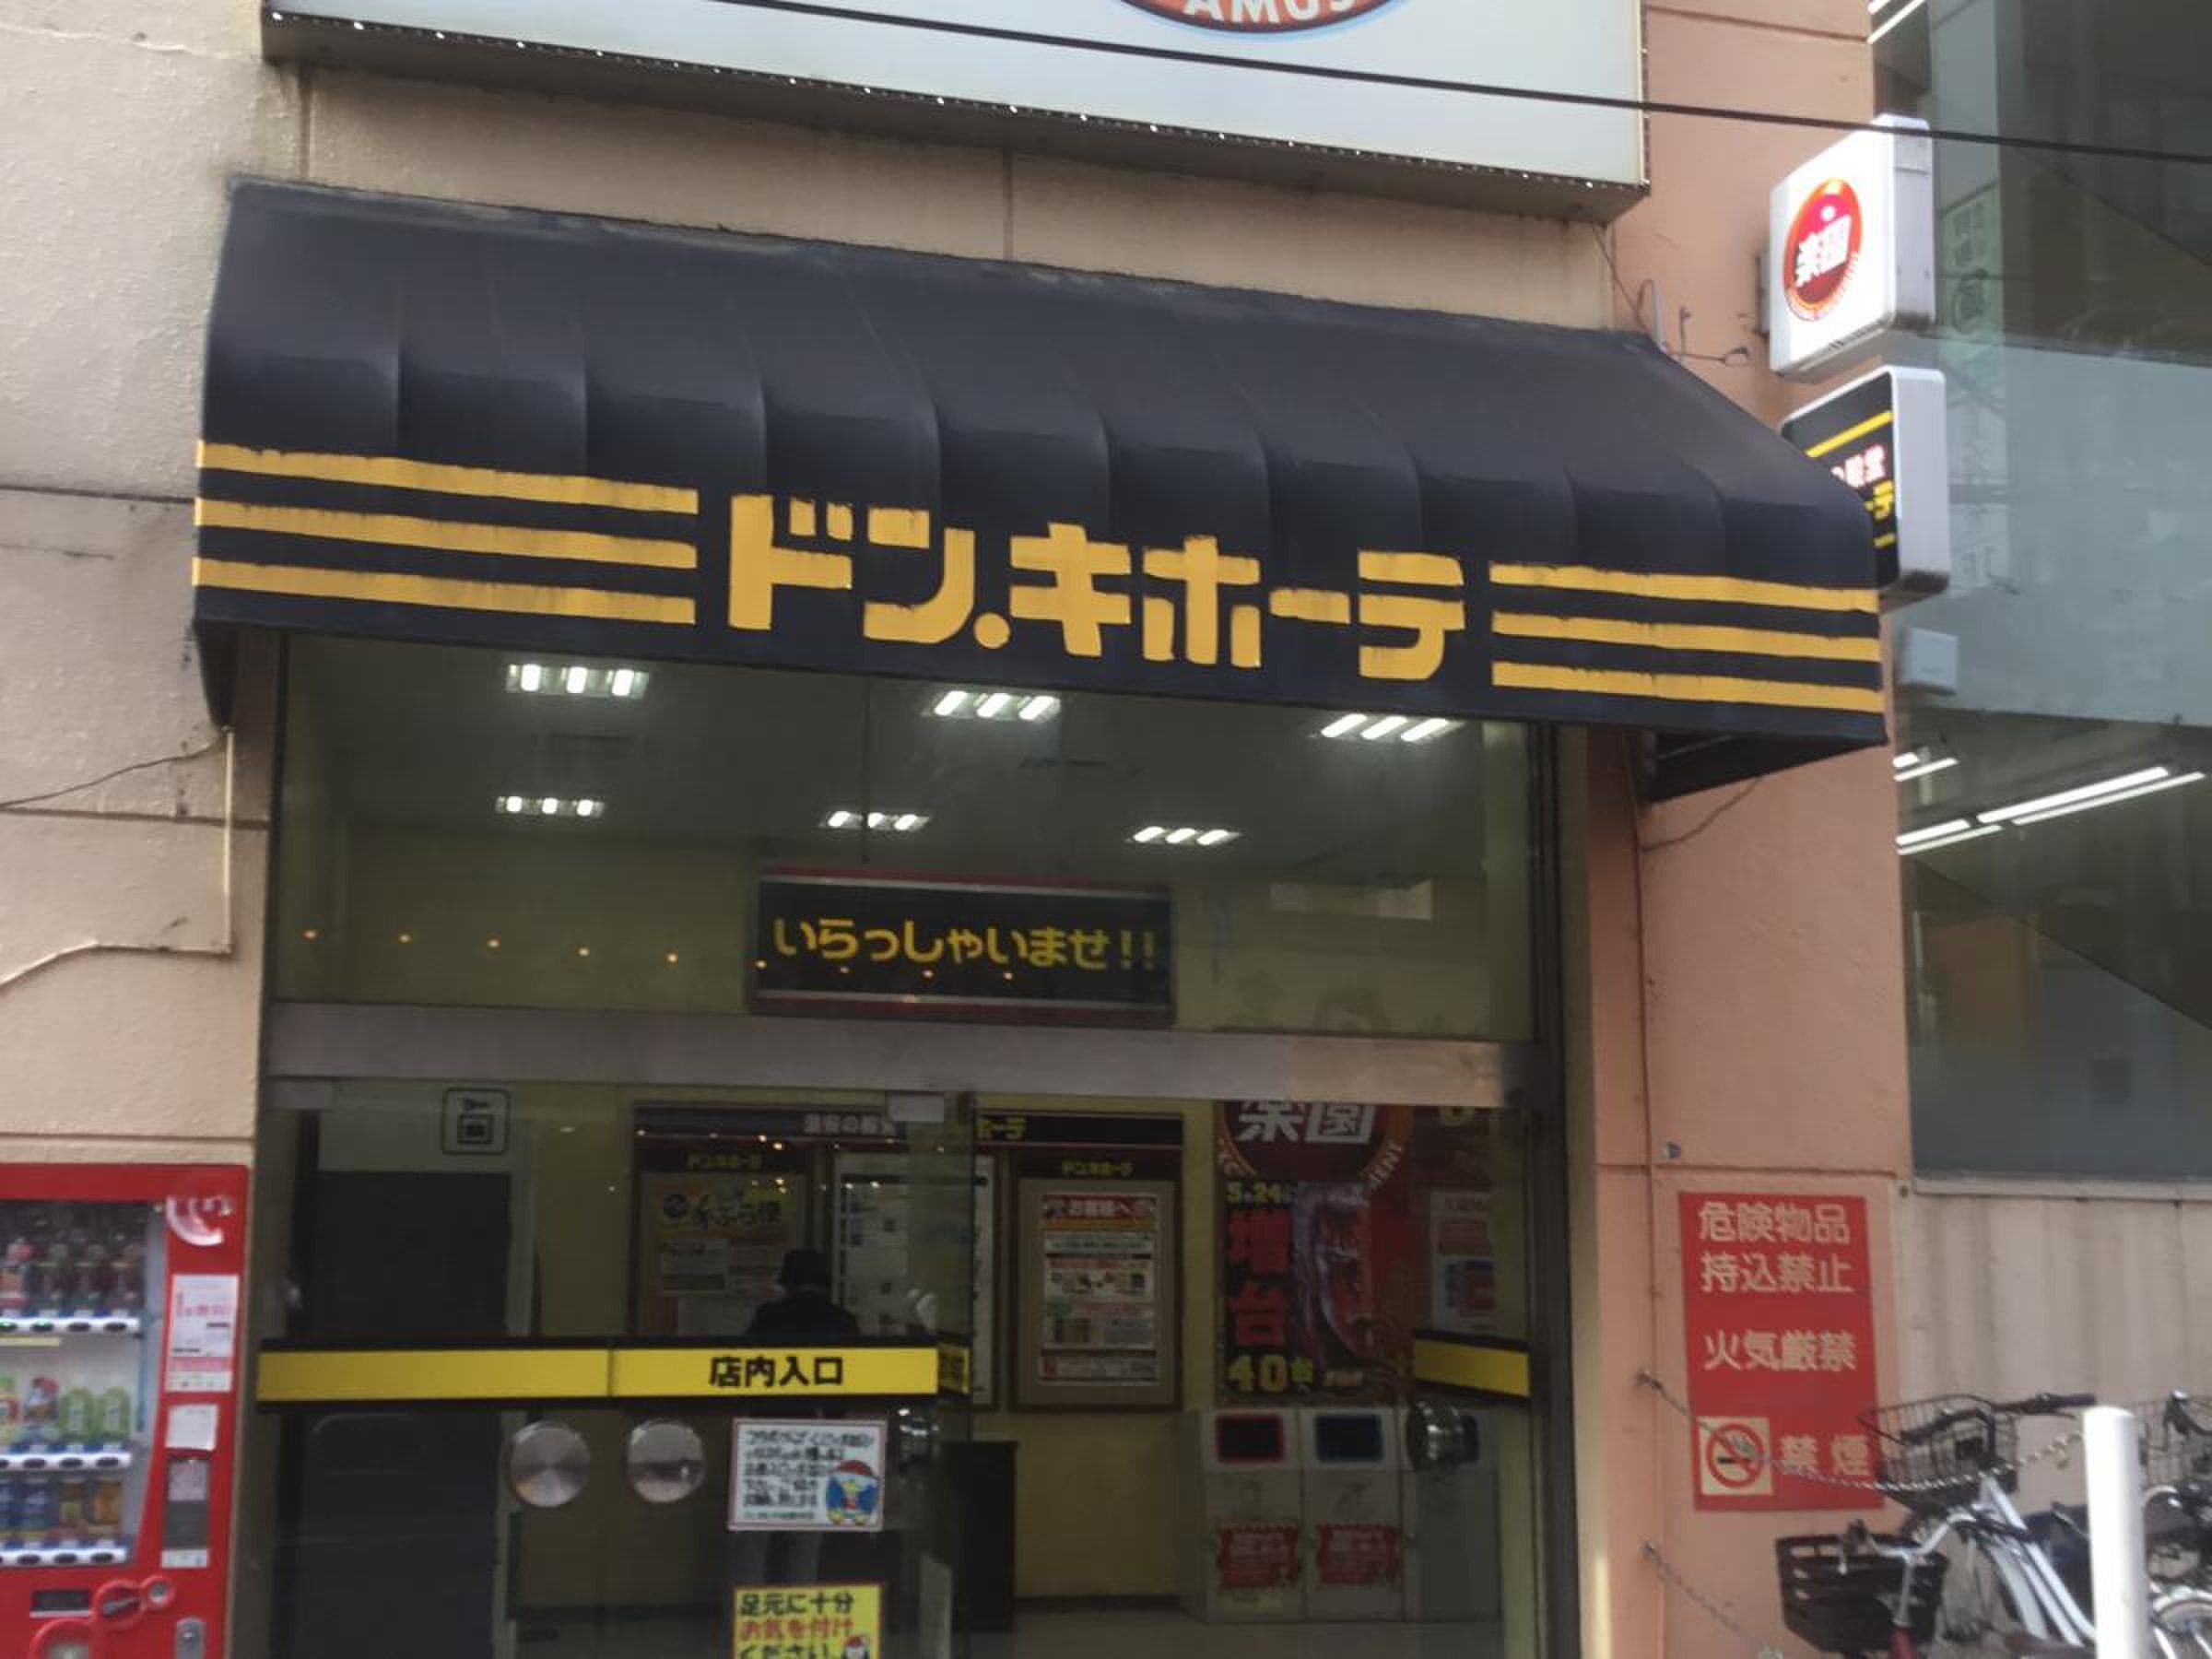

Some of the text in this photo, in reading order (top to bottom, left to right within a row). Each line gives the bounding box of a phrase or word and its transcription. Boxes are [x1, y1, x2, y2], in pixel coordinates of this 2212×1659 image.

[1697, 1201, 1851, 1244] 危険物品
[1700, 1252, 1855, 1295] 持込禁止
[708, 1355, 846, 1388] 店内入口
[1703, 1330, 1858, 1373] 火気厳禁
[740, 1593, 854, 1617] 足元に十分
